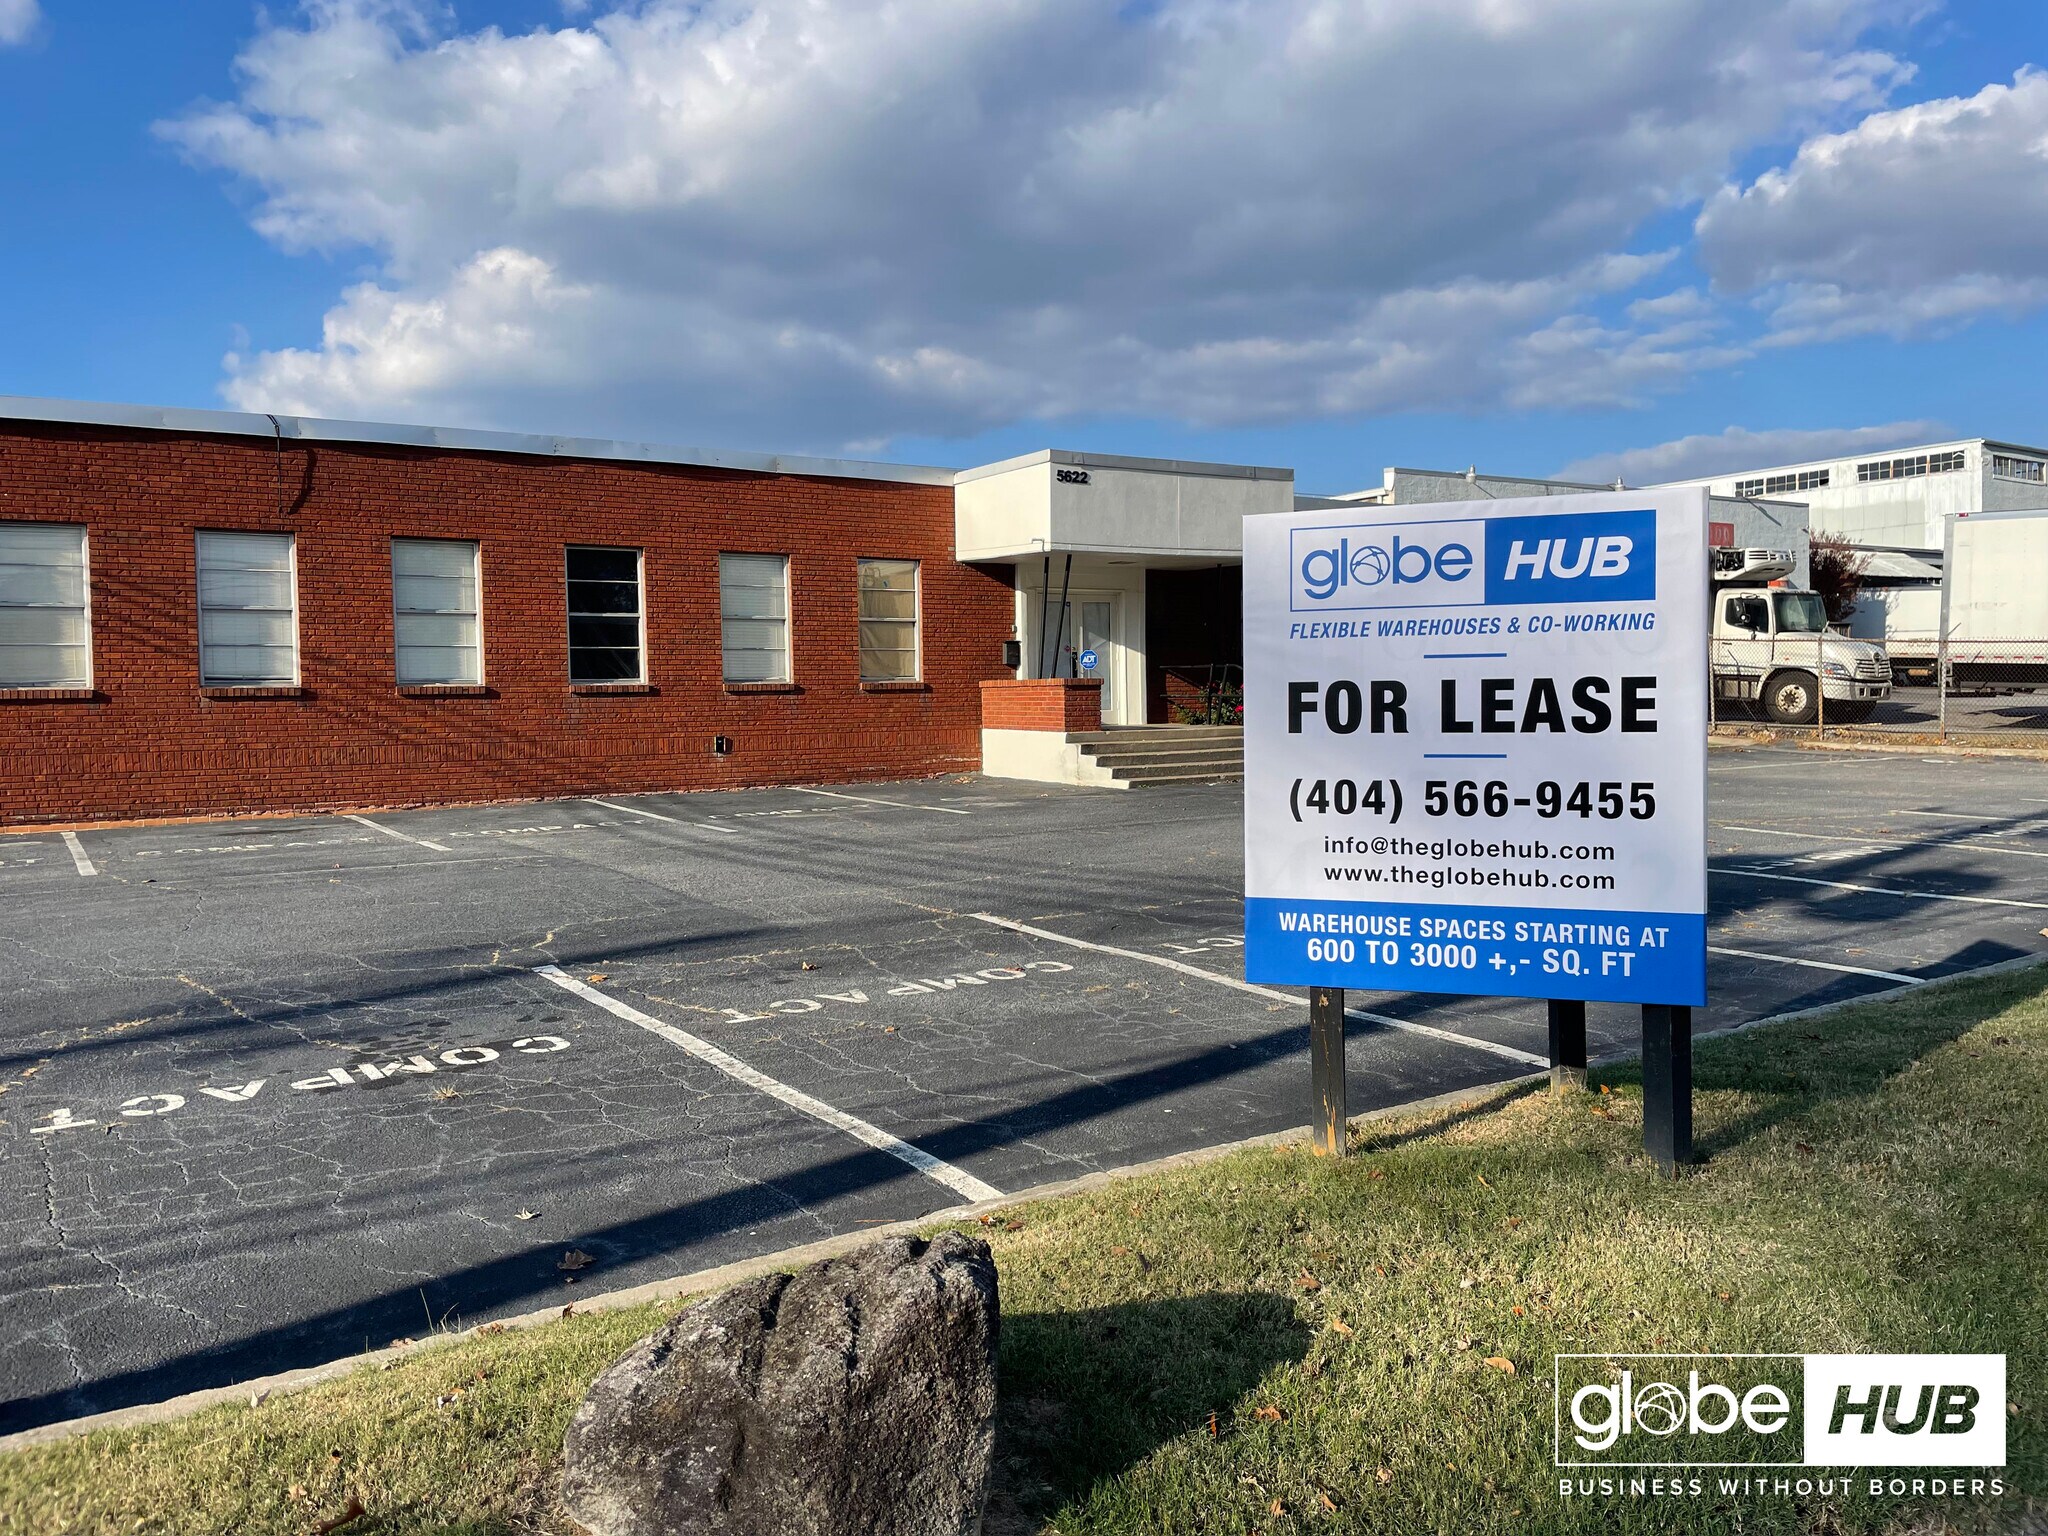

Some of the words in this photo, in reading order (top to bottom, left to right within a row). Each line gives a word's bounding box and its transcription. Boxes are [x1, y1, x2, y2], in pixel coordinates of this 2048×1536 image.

[1056, 469, 1088, 484] 5622
[1302, 536, 1473, 600] globe
[1504, 536, 1634, 581] HUB
[1290, 620, 1371, 640] FLEXIBLE
[1378, 617, 1502, 637] WAREHOUSES
[1507, 617, 1521, 634] &
[1528, 612, 1656, 634] CO-WORKING
[1082, 655, 1096, 663] ADT
[1288, 680, 1410, 734] FOR
[1441, 676, 1658, 734] LEASE
[1290, 778, 1402, 824] (404)
[1424, 780, 1656, 820] 566-9455
[1324, 836, 1616, 861] info@theglobehub.com
[1324, 865, 1616, 890] www.theglobehub.com
[1279, 912, 1412, 937] WAREHOUSE
[1420, 917, 1506, 941] SPACES
[1514, 921, 1630, 947] STARTING
[1640, 927, 1669, 948] AT
[1307, 938, 1355, 963] 600
[1366, 940, 1399, 965] TO
[1410, 942, 1477, 968] 3000
[1542, 951, 1590, 976] SQ.
[1602, 952, 1636, 977] FT
[723, 961, 1074, 1024] COMPACT
[30, 1035, 571, 1134] COMPACT
